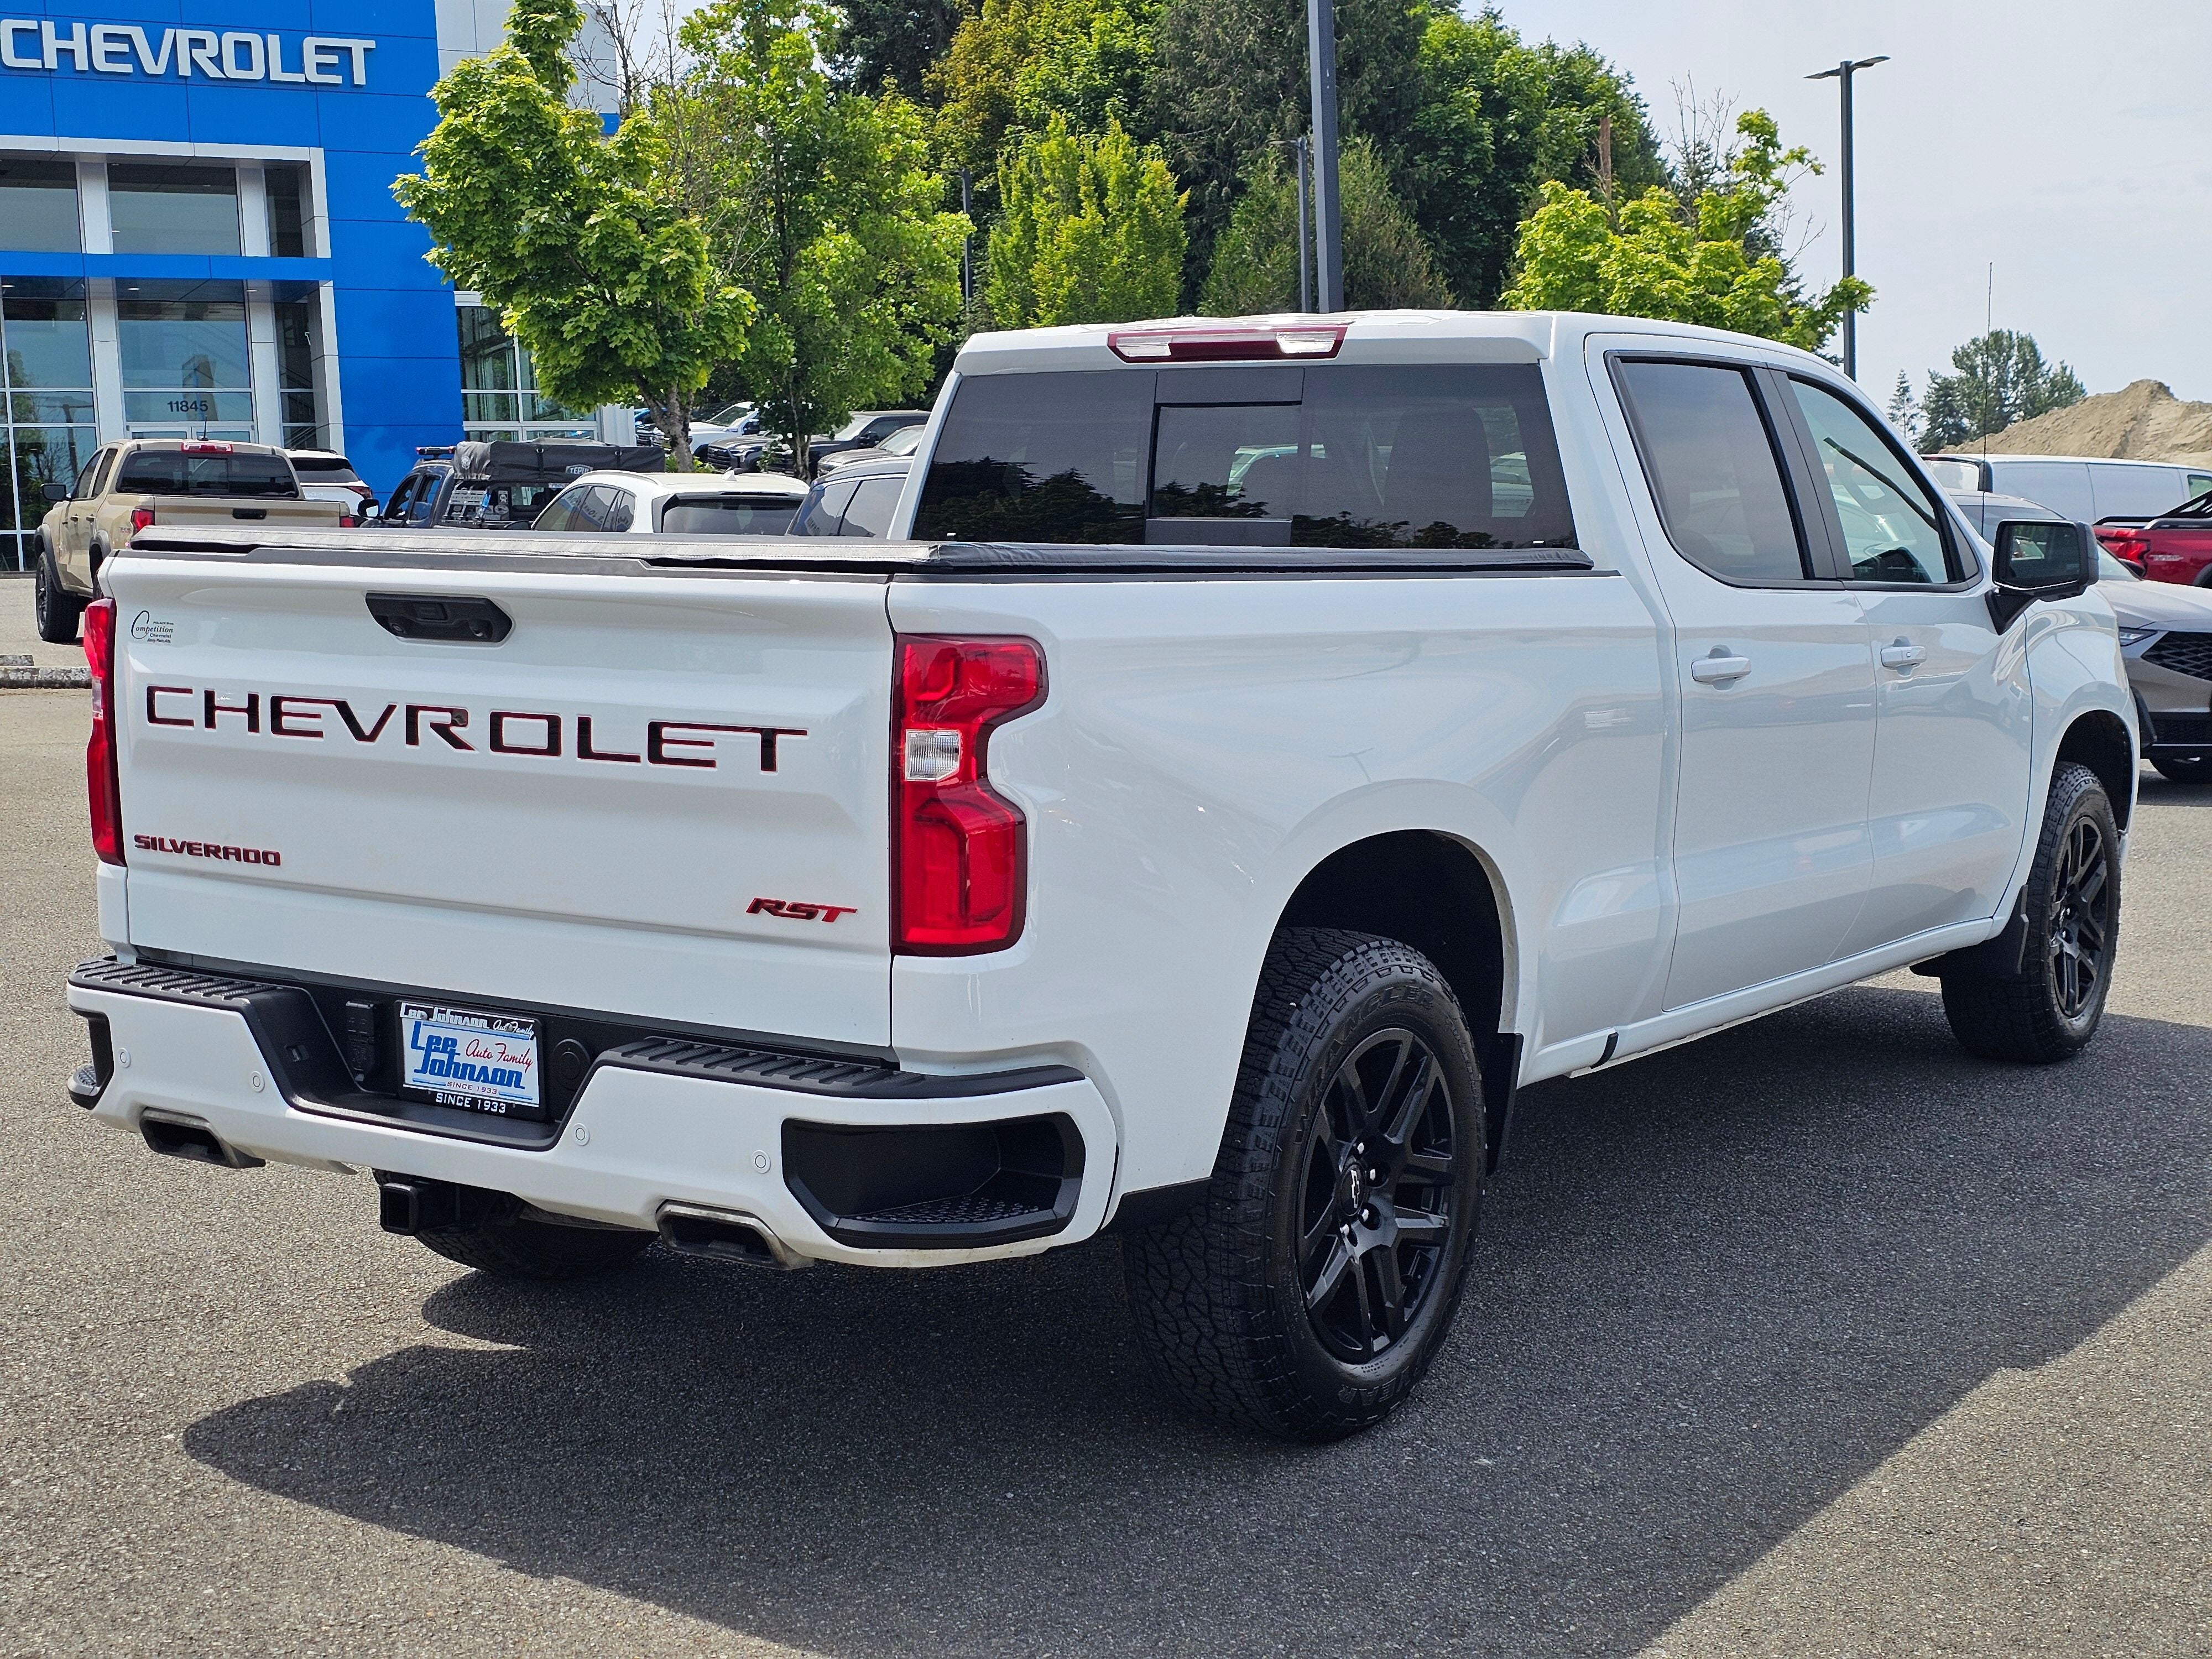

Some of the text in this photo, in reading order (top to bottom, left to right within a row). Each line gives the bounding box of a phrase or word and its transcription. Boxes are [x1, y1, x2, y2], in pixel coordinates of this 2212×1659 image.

[0, 19, 376, 85] CHEVROLET
[167, 400, 208, 412] 11845
[131, 610, 174, 640] Competition
[146, 685, 809, 774] CHEVROLET
[134, 834, 281, 866] SILVERADO
[745, 897, 858, 923] RST
[429, 1006, 490, 1029] Johnson
[493, 1020, 513, 1032] Aut
[510, 1021, 535, 1038] Family
[410, 1021, 461, 1056] Lee
[465, 1039, 494, 1060] Auto
[494, 1042, 533, 1073] Family
[414, 1050, 525, 1089] Johnson
[435, 1093, 506, 1113] SINCE 1933
[447, 1081, 498, 1094] SINCE 1933
